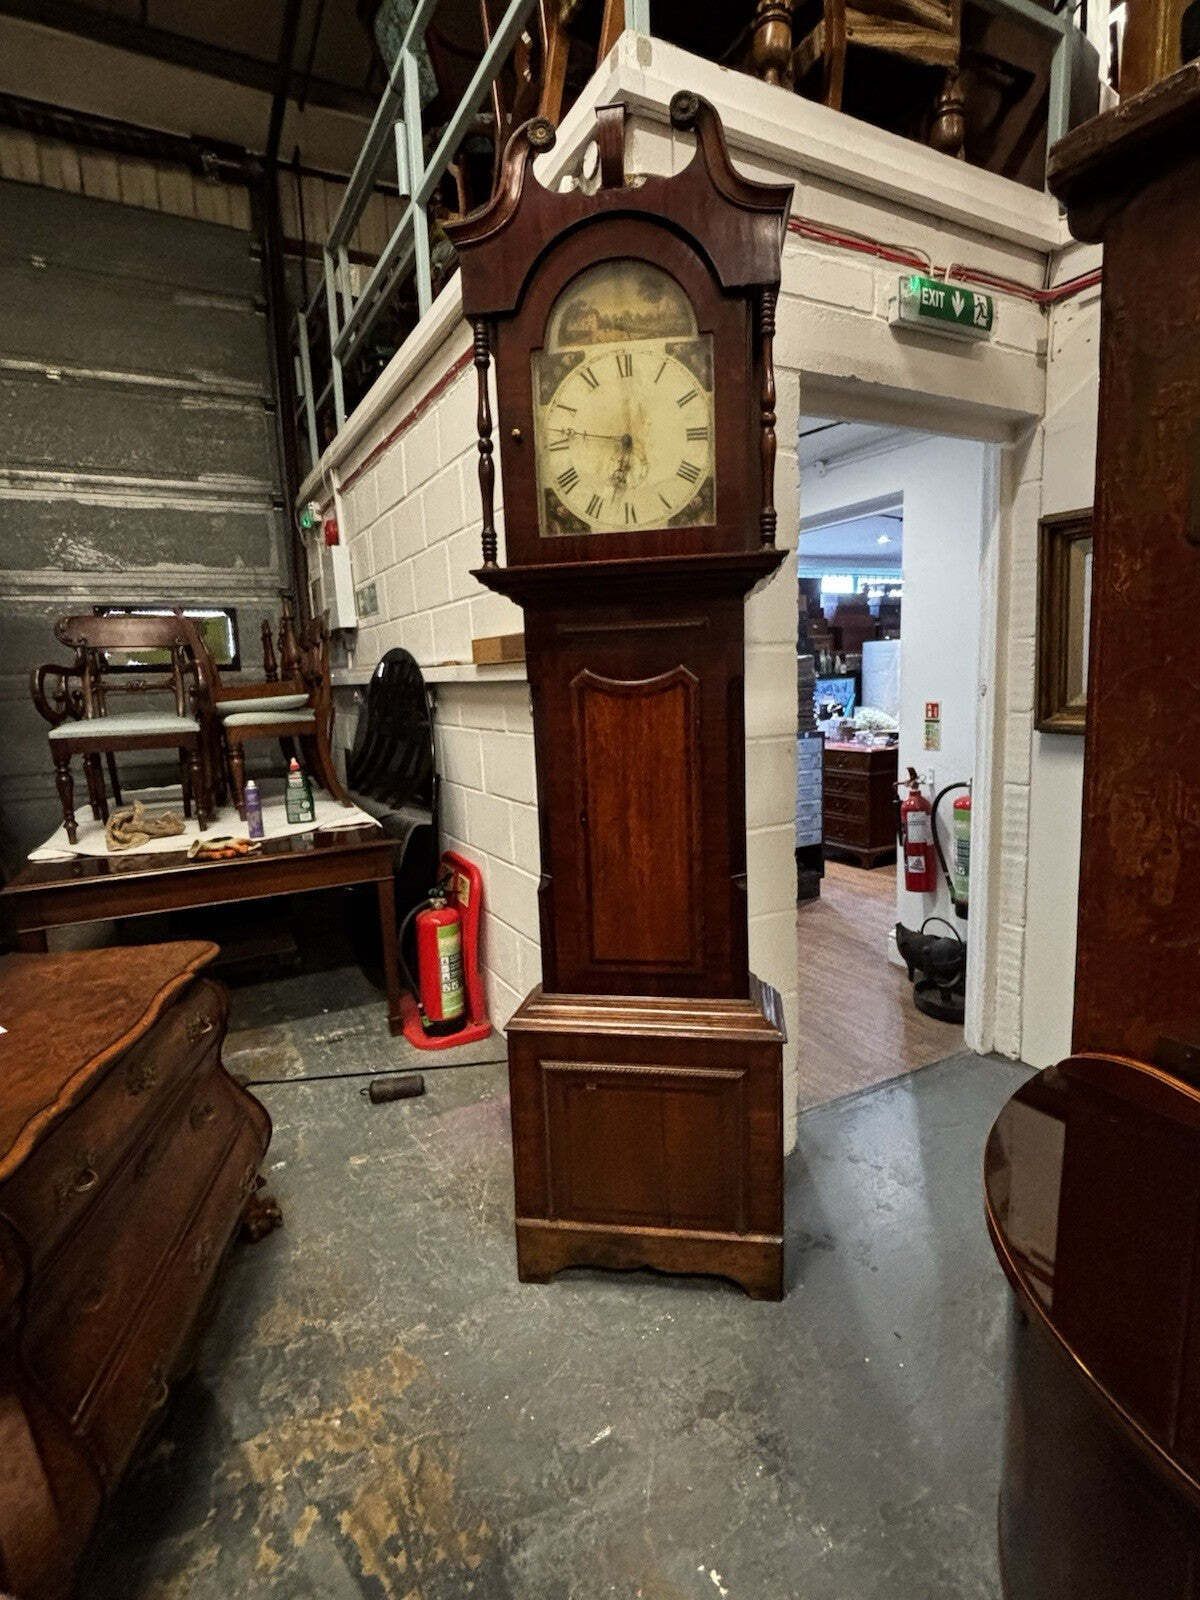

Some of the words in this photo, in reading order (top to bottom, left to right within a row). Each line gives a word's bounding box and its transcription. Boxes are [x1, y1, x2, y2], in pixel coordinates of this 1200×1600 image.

[921, 287, 945, 309] EXIT
[654, 361, 667, 384] I
[676, 389, 699, 408] II
[685, 427, 709, 442] III
